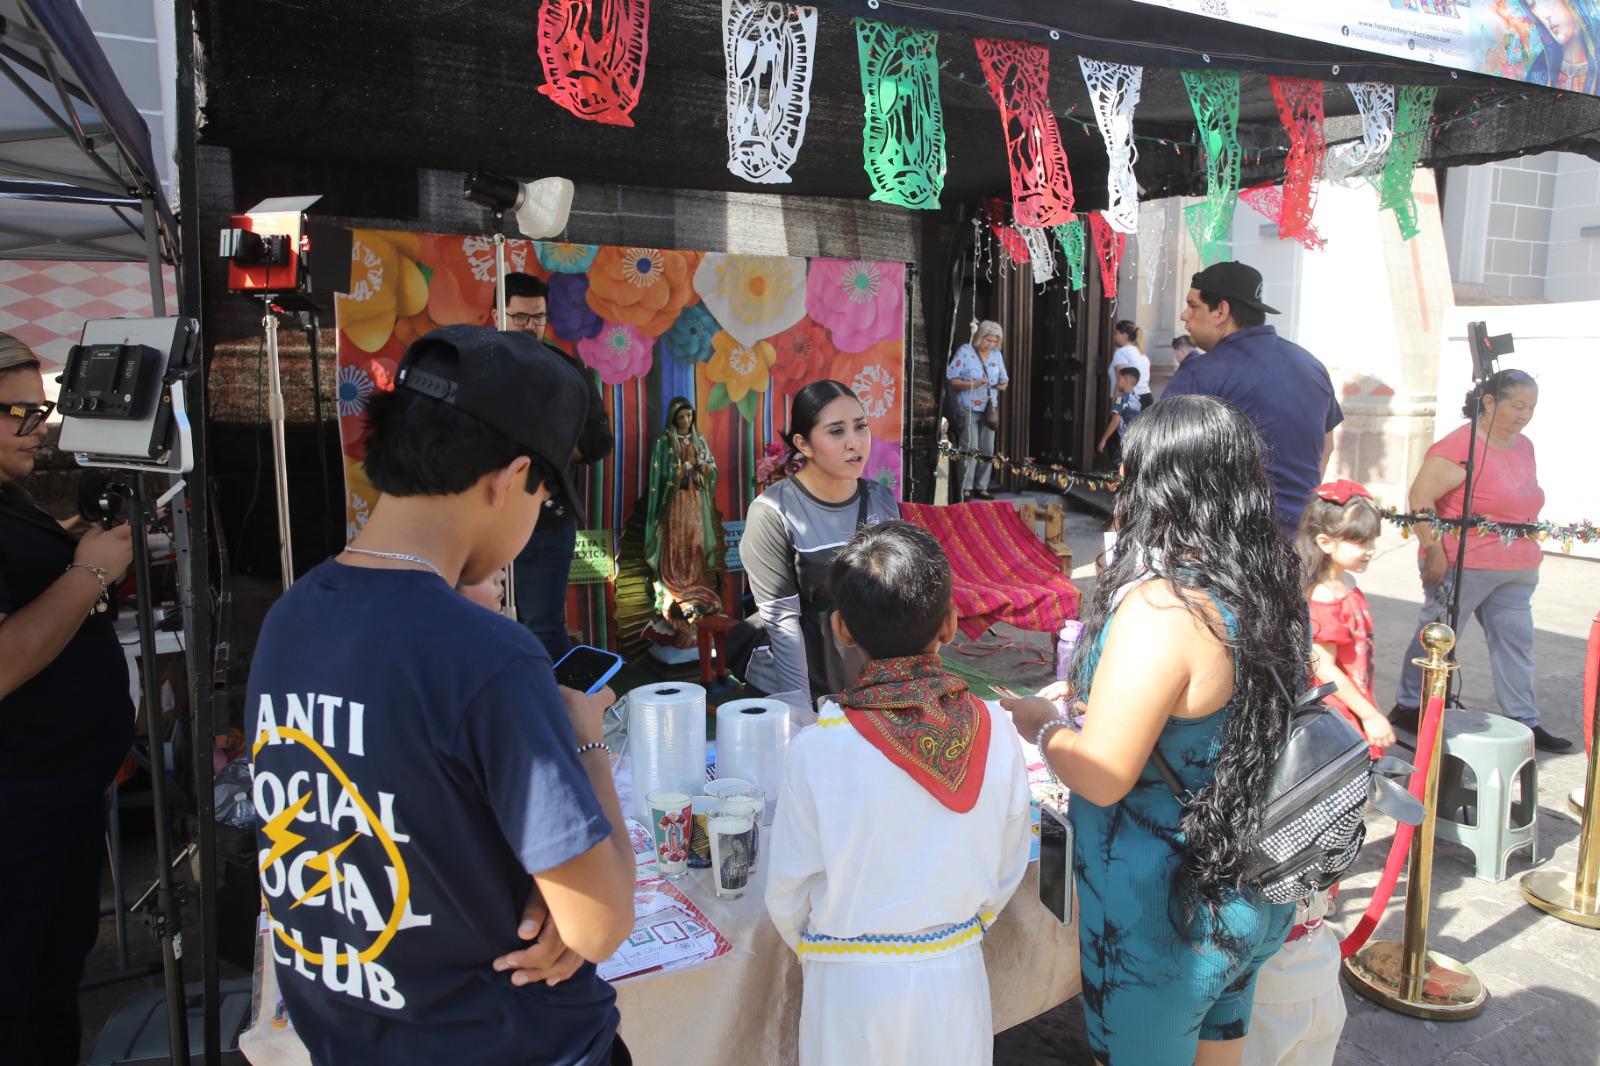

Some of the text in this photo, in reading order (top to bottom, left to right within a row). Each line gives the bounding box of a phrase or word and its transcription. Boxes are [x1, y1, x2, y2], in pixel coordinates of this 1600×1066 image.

[575, 550, 606, 559] EXICO
[255, 692, 365, 756] ANTI
[249, 763, 410, 842] OCIAL
[258, 847, 432, 932] OCIAL
[270, 920, 406, 1009] CLUB
